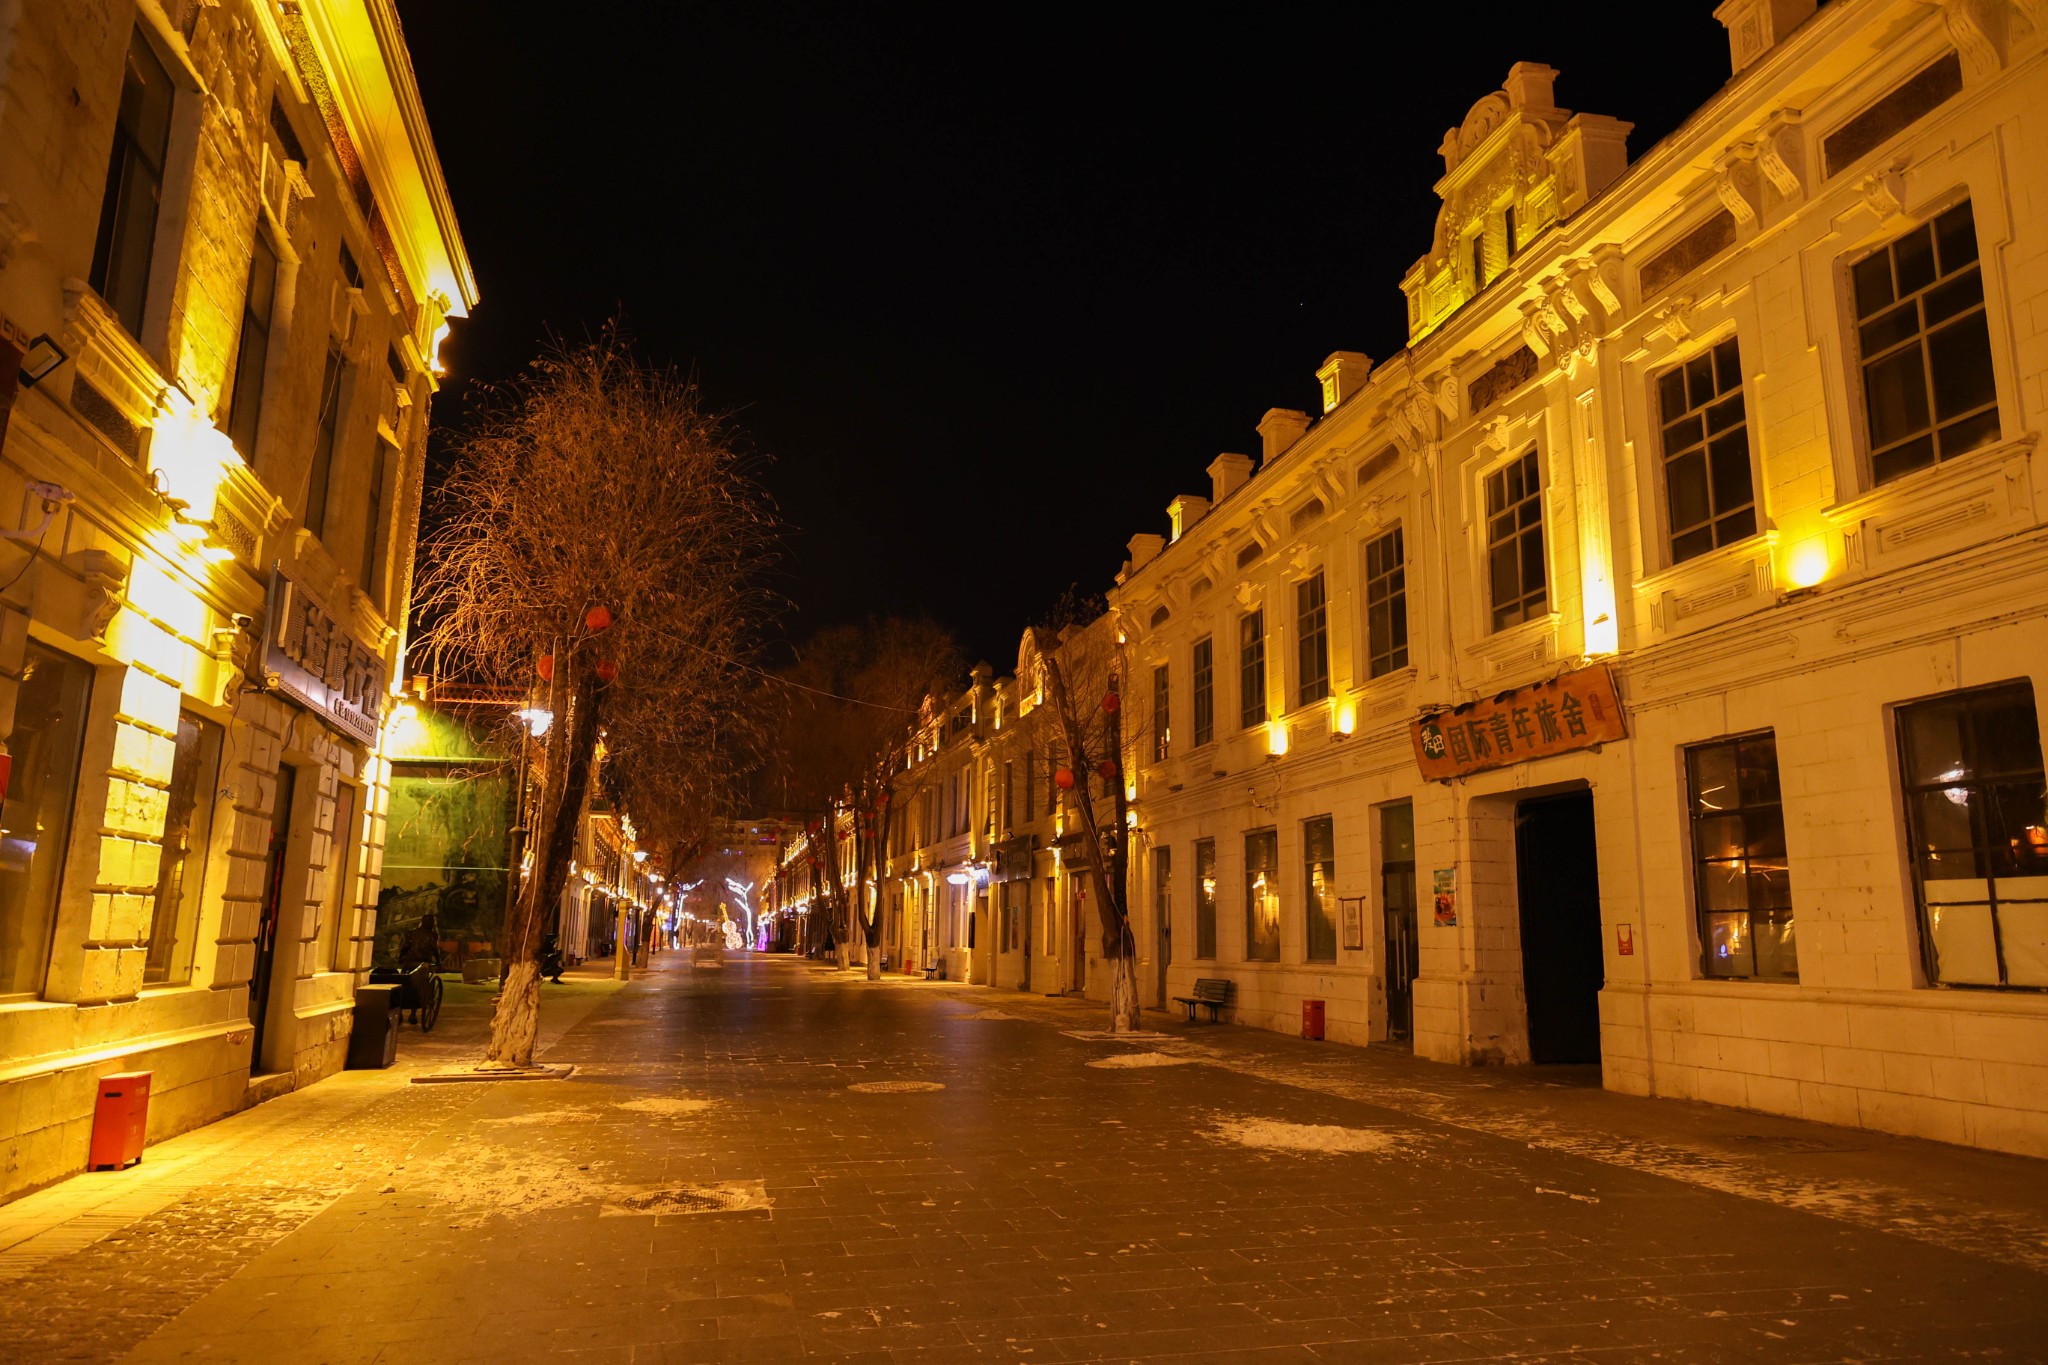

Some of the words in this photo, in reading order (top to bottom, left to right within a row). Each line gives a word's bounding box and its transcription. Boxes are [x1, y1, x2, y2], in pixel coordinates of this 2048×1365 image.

[1448, 692, 1587, 766] 国际青年旅舍
